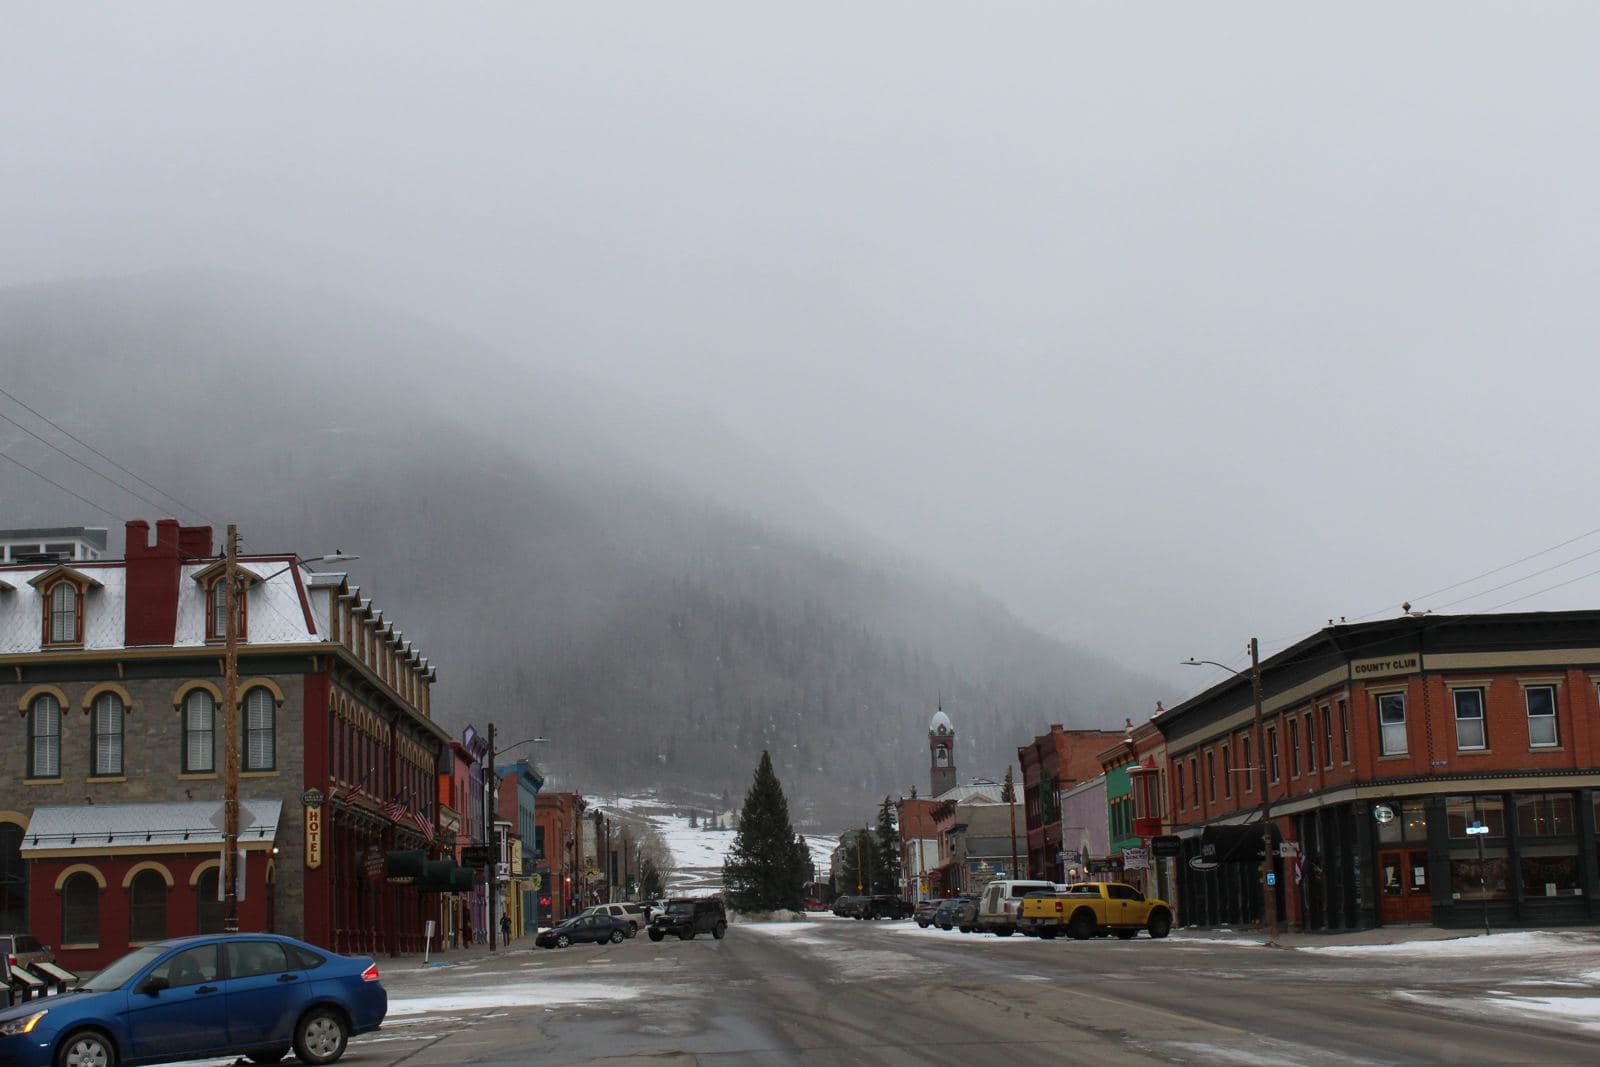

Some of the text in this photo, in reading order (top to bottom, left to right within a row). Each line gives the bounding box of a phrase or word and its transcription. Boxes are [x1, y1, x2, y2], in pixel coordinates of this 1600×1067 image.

[1355, 658, 1417, 673] COUNTY CLUB
[309, 811, 318, 863] HOTEL
